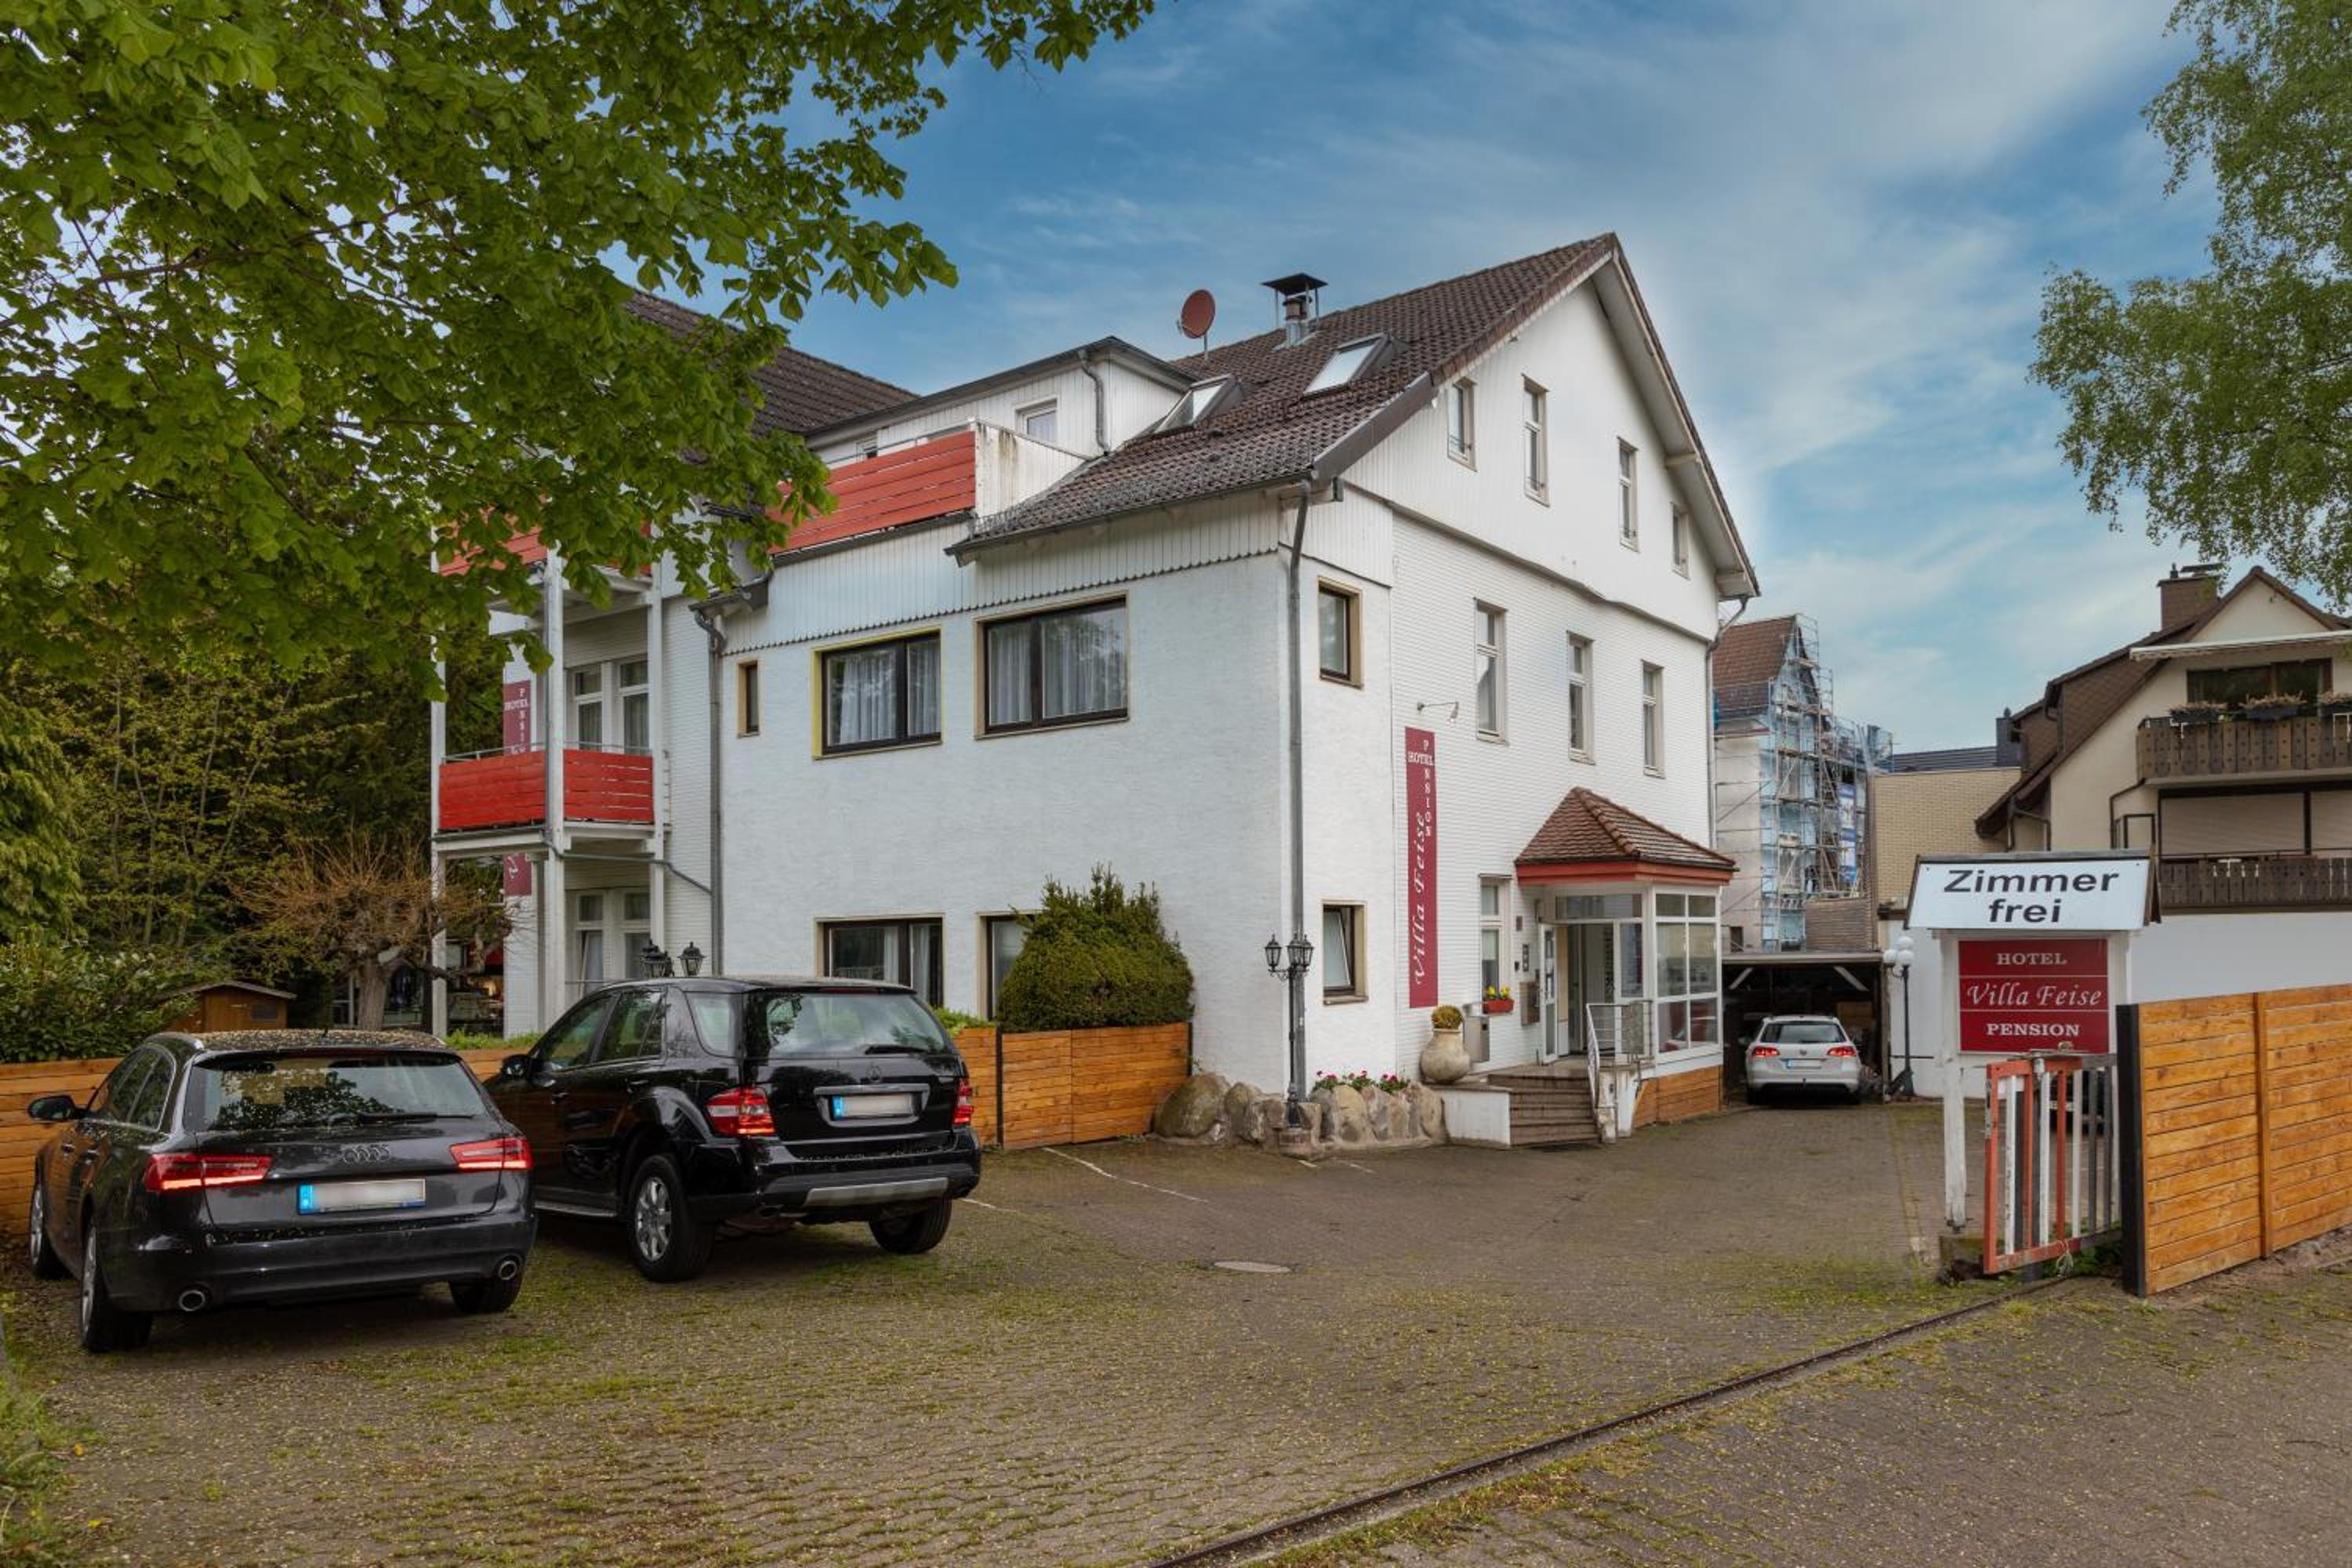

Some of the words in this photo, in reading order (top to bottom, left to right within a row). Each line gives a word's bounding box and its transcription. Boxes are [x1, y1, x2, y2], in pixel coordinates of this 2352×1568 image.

[1407, 751, 1435, 765] HOTEL
[1413, 812, 1426, 894] Feise
[1944, 869, 2119, 893] Zimmer
[1989, 898, 2062, 923] frei
[1415, 903, 1426, 985] Villa
[1996, 953, 2067, 966] HOTEL
[1967, 982, 2029, 1006] Villa
[2036, 984, 2102, 1006] Feise
[1986, 1023, 2080, 1036] PENSION
